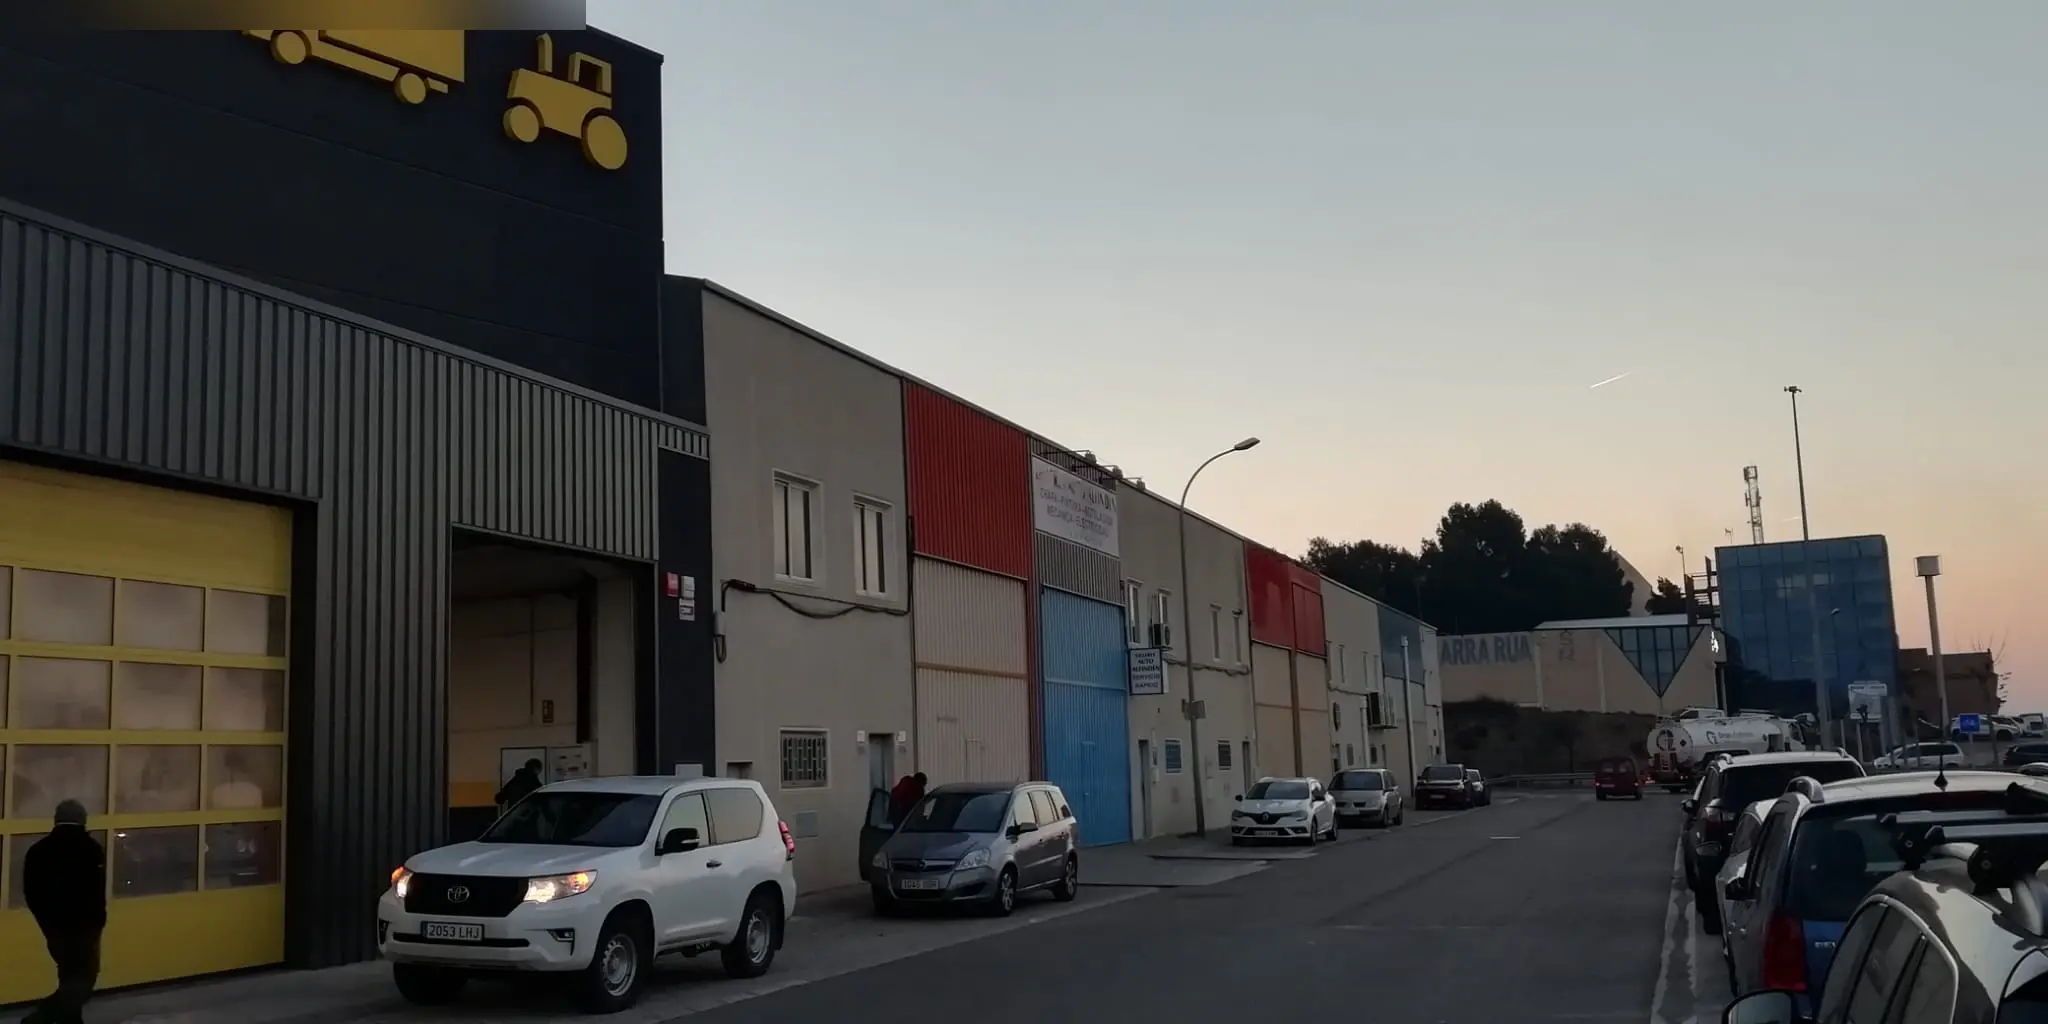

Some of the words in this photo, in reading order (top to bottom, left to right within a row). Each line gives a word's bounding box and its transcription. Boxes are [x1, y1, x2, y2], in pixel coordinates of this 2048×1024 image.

[1494, 635, 1532, 662] RUA
[428, 924, 456, 937] 2053
[459, 926, 480, 938] LHJ
